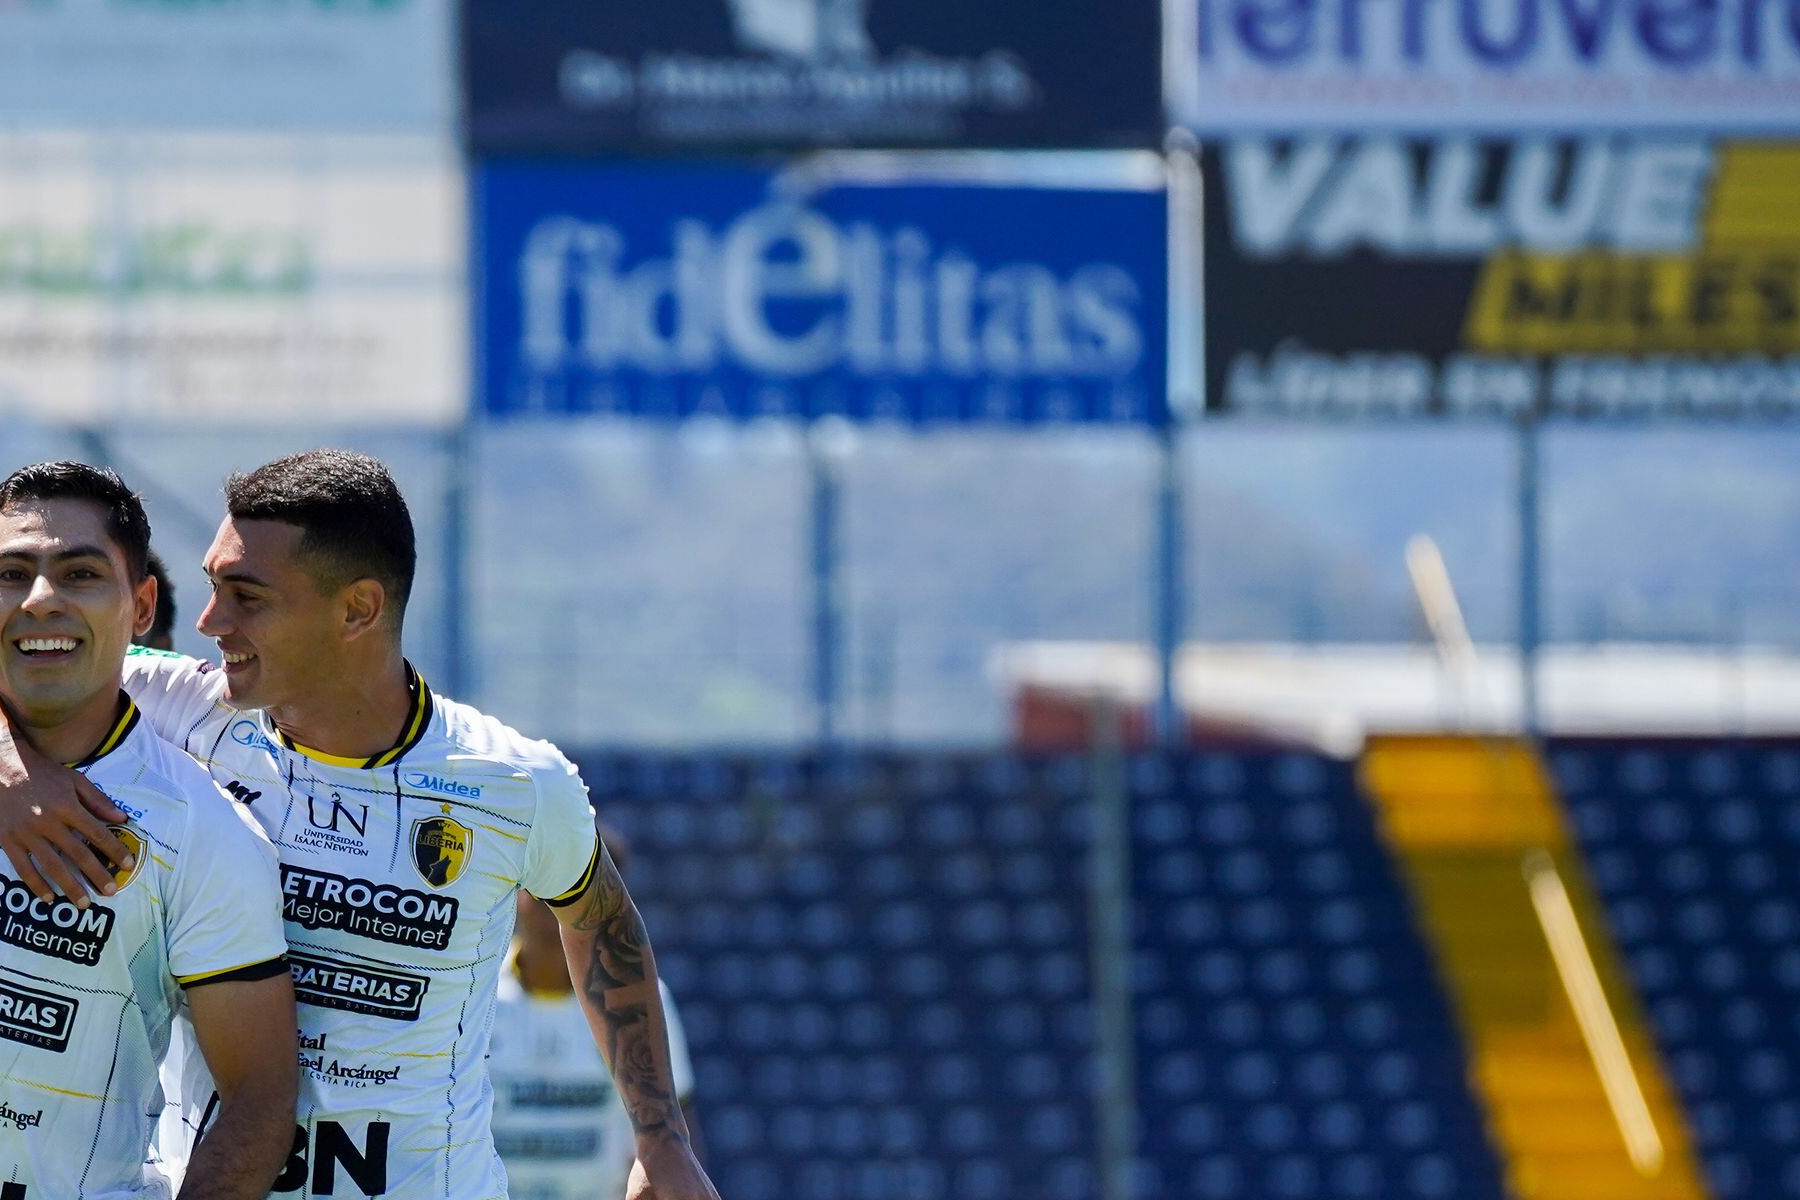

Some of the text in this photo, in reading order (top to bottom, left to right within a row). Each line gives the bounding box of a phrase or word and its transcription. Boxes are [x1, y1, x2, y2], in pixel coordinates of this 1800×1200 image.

[1220, 136, 1710, 262] VALUE
[404, 774, 480, 799] Midea
[294, 834, 369, 857] ISAAC NEWTON
[303, 828, 363, 848] UNIVERSIDAD
[283, 871, 452, 925] ETROCOM
[3, 914, 98, 961] Internet
[349, 909, 446, 946] Internet
[290, 963, 411, 1002] BATERIAS
[309, 1072, 367, 1089] COSTA RICA
[326, 1060, 400, 1085] Arcángel
